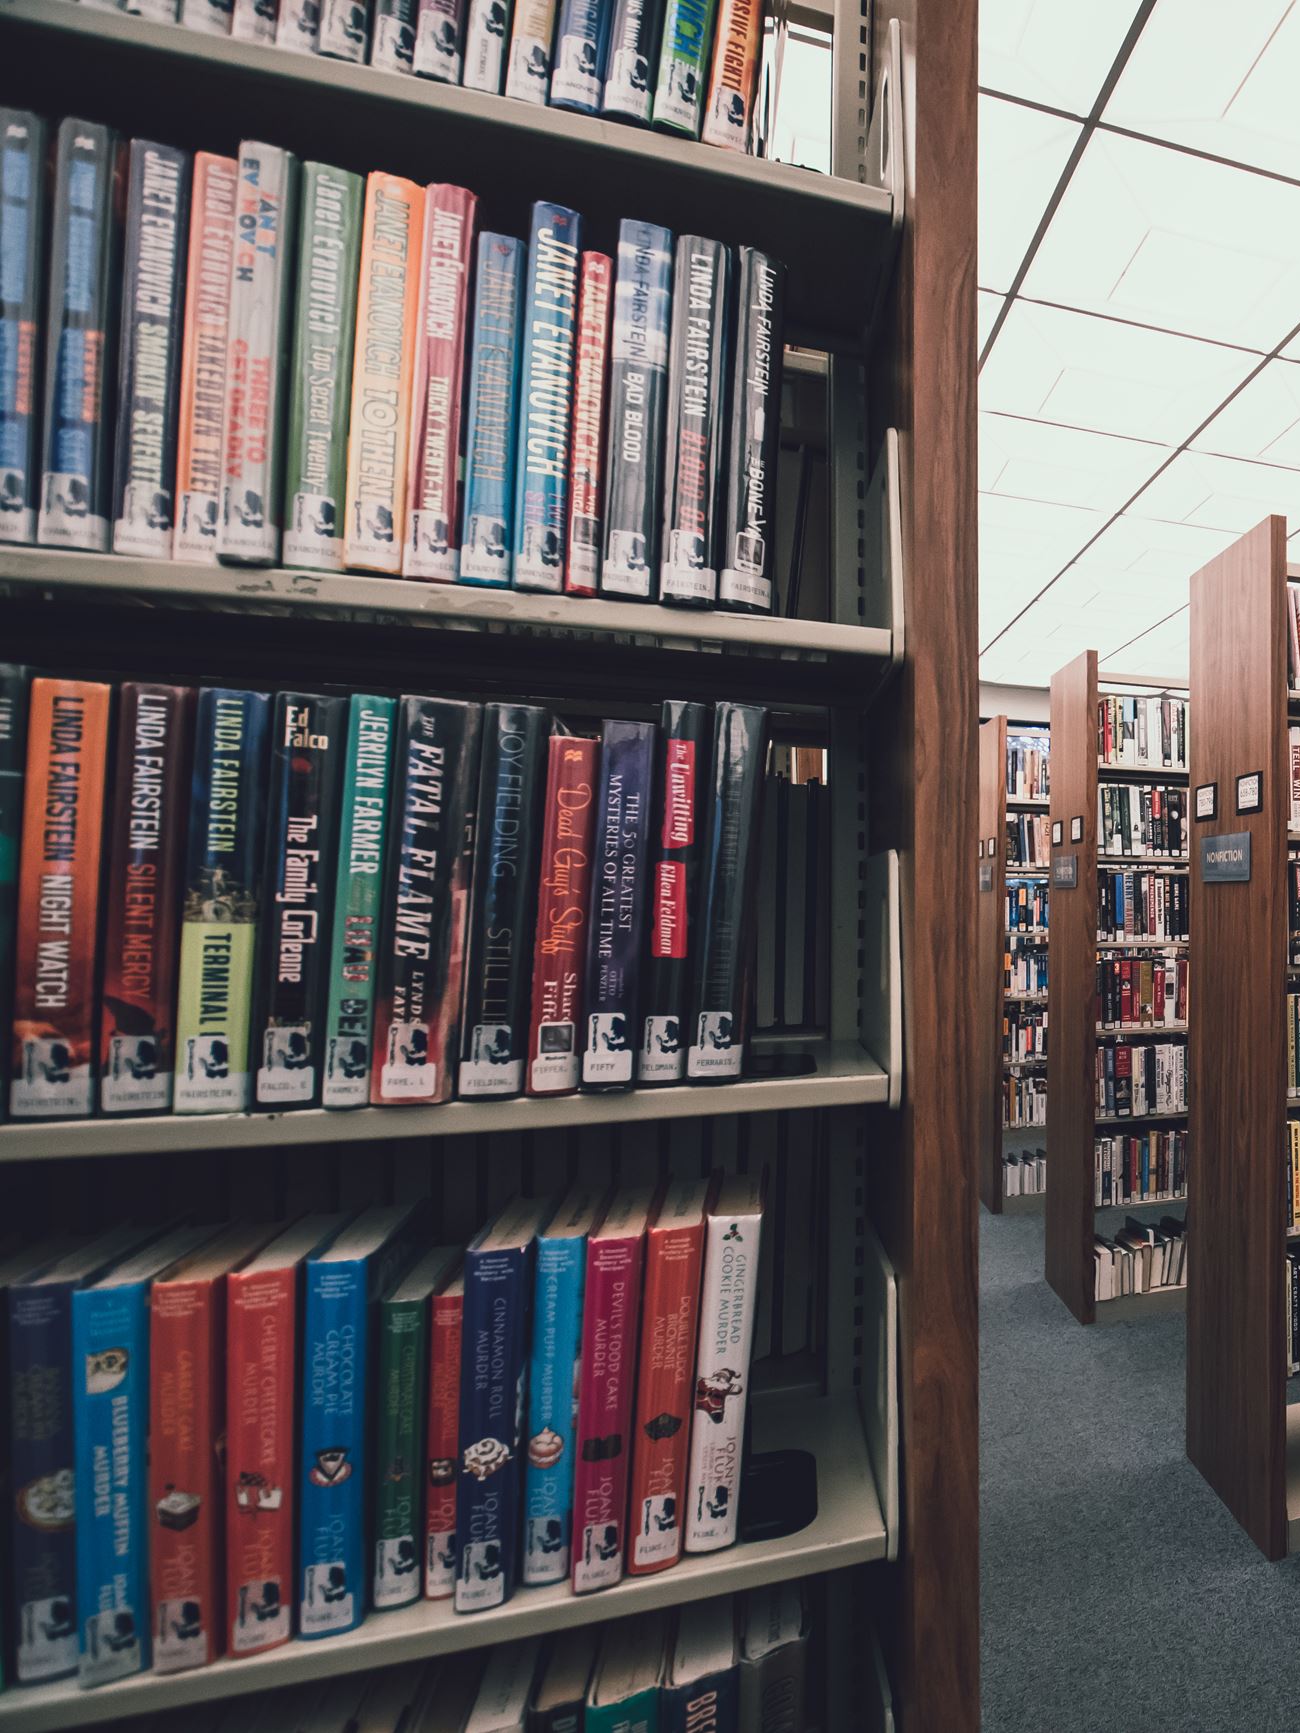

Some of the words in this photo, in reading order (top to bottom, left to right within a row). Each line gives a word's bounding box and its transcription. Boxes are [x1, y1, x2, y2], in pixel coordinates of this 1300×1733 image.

[142, 151, 179, 213] JANET
[373, 188, 411, 262] JANET
[430, 207, 464, 260] JANET
[136, 214, 176, 317] EVANOVICH
[533, 227, 579, 321] JANET
[689, 252, 714, 310] LINDA
[752, 264, 777, 312] LINDA
[364, 259, 408, 381] EVANOVICH
[426, 255, 465, 341] EVANOVICH
[478, 260, 515, 334] JANET
[623, 278, 652, 362] FAIRSTEIN
[133, 321, 168, 406] SMOKIN'
[309, 344, 337, 372] Top
[685, 315, 711, 417] FAIRSTEIN
[747, 314, 773, 396] FAIRSTEIN
[307, 374, 334, 427] Secret
[427, 375, 449, 429] TRICKY
[473, 343, 513, 481] EVANOVICH
[526, 319, 575, 480] EVANOVICH
[622, 370, 645, 406] BAD
[622, 409, 644, 463] BLOOD
[748, 464, 765, 516] BONE
[51, 696, 83, 754] LINDA
[135, 694, 167, 750] LINDA
[213, 700, 244, 752] LINDA
[285, 727, 329, 750] Falco
[286, 706, 309, 727] Ed
[421, 714, 435, 738] THE
[355, 709, 389, 789] JERRILYN
[674, 743, 688, 762] The
[1291, 746, 1300, 771] TELL
[44, 761, 80, 861] FAIRSTEIN
[129, 755, 164, 850] FAIRSTEIN
[208, 758, 240, 852] FAIRSTEIN
[403, 738, 446, 835] FATAL
[555, 782, 592, 840] Dead
[626, 792, 640, 824] THE
[1292, 779, 1300, 800] WIN
[287, 814, 318, 843] The
[349, 796, 384, 875] FARMER
[491, 773, 523, 877] FIELDING
[605, 774, 623, 858] MYSTERIES
[621, 828, 638, 850] 50
[275, 849, 320, 903] Family
[602, 863, 617, 886] OF
[659, 863, 676, 897] Ellen
[1207, 849, 1243, 863] NONFICTION
[39, 874, 73, 934] NIGHT
[125, 863, 156, 926] SILENT
[393, 843, 439, 960] FLAME
[600, 890, 615, 915] ALL
[617, 854, 637, 932] GREATEST
[278, 909, 319, 983] Corleone
[599, 918, 614, 958] TIME
[659, 900, 677, 955] Feldman
[35, 941, 70, 1007] WATCH
[121, 934, 152, 999] MERCY
[199, 933, 232, 1025] TERMINAL
[484, 926, 512, 990] STILL
[543, 1274, 559, 1323] CREAM
[719, 1245, 735, 1295] COOKIE
[728, 1253, 748, 1345] GINGERBREAD
[490, 1297, 507, 1384] CINNAMON
[592, 1318, 608, 1378] MURDER
[650, 1315, 666, 1371] MURDER
[662, 1312, 679, 1371] BROWNIE
[677, 1295, 692, 1346] DOUBLE
[715, 1298, 731, 1356] MURDER
[311, 1341, 326, 1406] MURDER
[326, 1329, 341, 1387] CREAM
[337, 1323, 356, 1416] CHOCOLATE
[474, 1329, 490, 1391] MURDER
[607, 1331, 623, 1373] FOOD
[673, 1347, 689, 1385] FUDGE
[323, 1389, 338, 1416] PIE
[488, 1387, 503, 1419] ROLL
[540, 1363, 554, 1421] MURDER
[604, 1374, 619, 1410] CAKE
[111, 1395, 129, 1487] BLUEBERRY
[113, 1490, 129, 1556] MUFFIN
